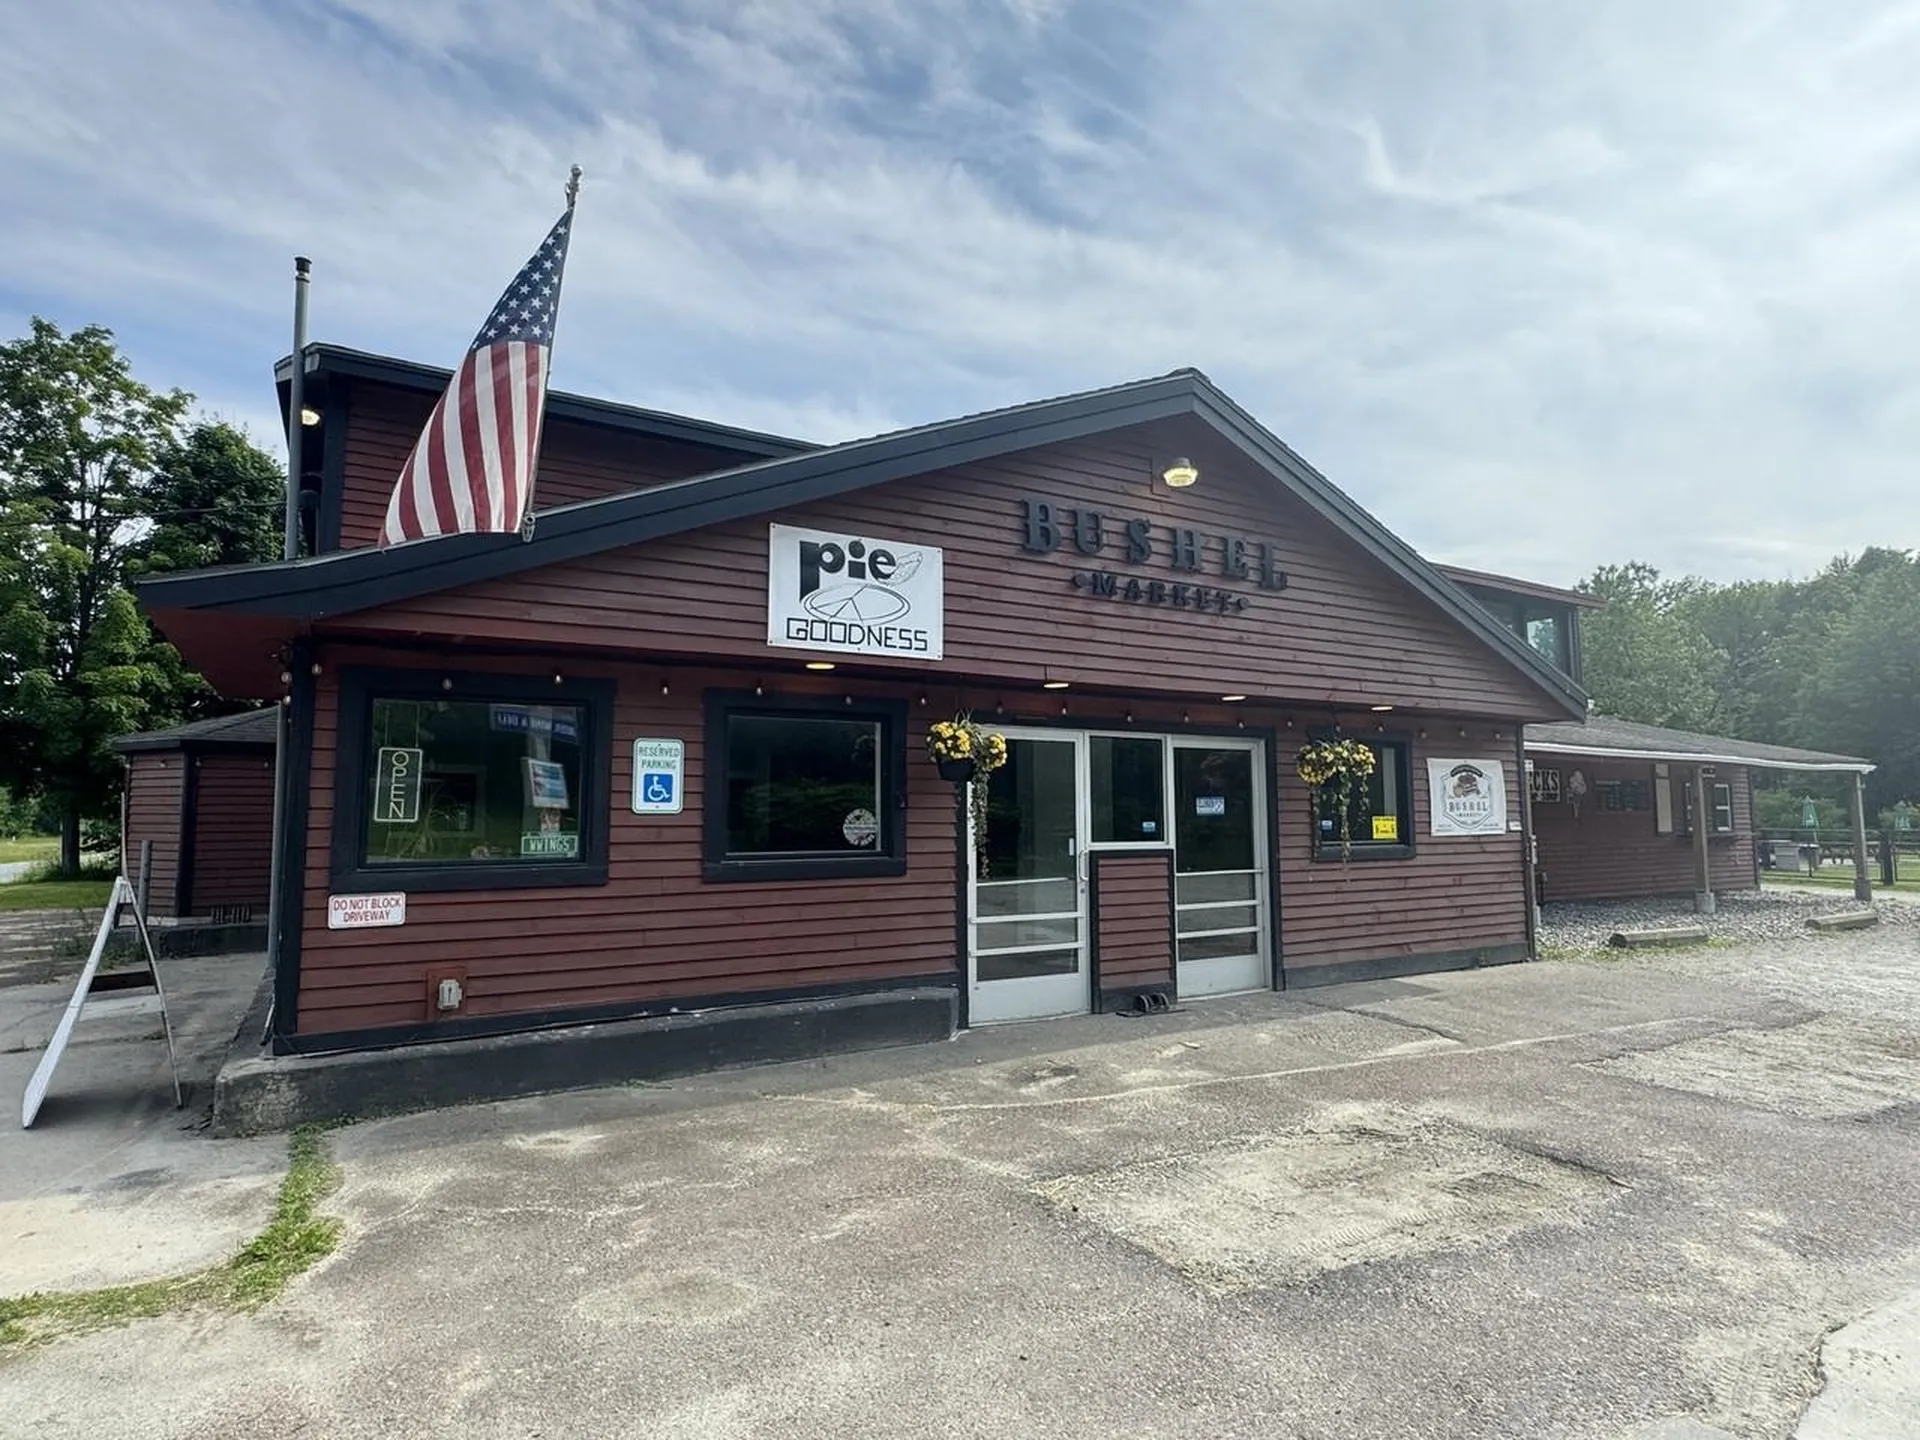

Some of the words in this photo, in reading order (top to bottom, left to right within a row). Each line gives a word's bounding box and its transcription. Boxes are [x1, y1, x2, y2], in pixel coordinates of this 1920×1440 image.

[1020, 500, 1288, 590] BUSHEL
[800, 538, 896, 603] pie
[1091, 572, 1233, 612] MARKET
[786, 617, 928, 651] GOODNESS
[639, 746, 679, 757] RESERVED
[641, 759, 676, 770] PARKING
[388, 751, 409, 819] OPEN
[1448, 800, 1488, 812] BUSHEL
[334, 899, 348, 911] DO
[349, 898, 370, 910] NOT
[371, 896, 401, 909] BLOCK
[343, 910, 391, 923] DRIVEWAY
